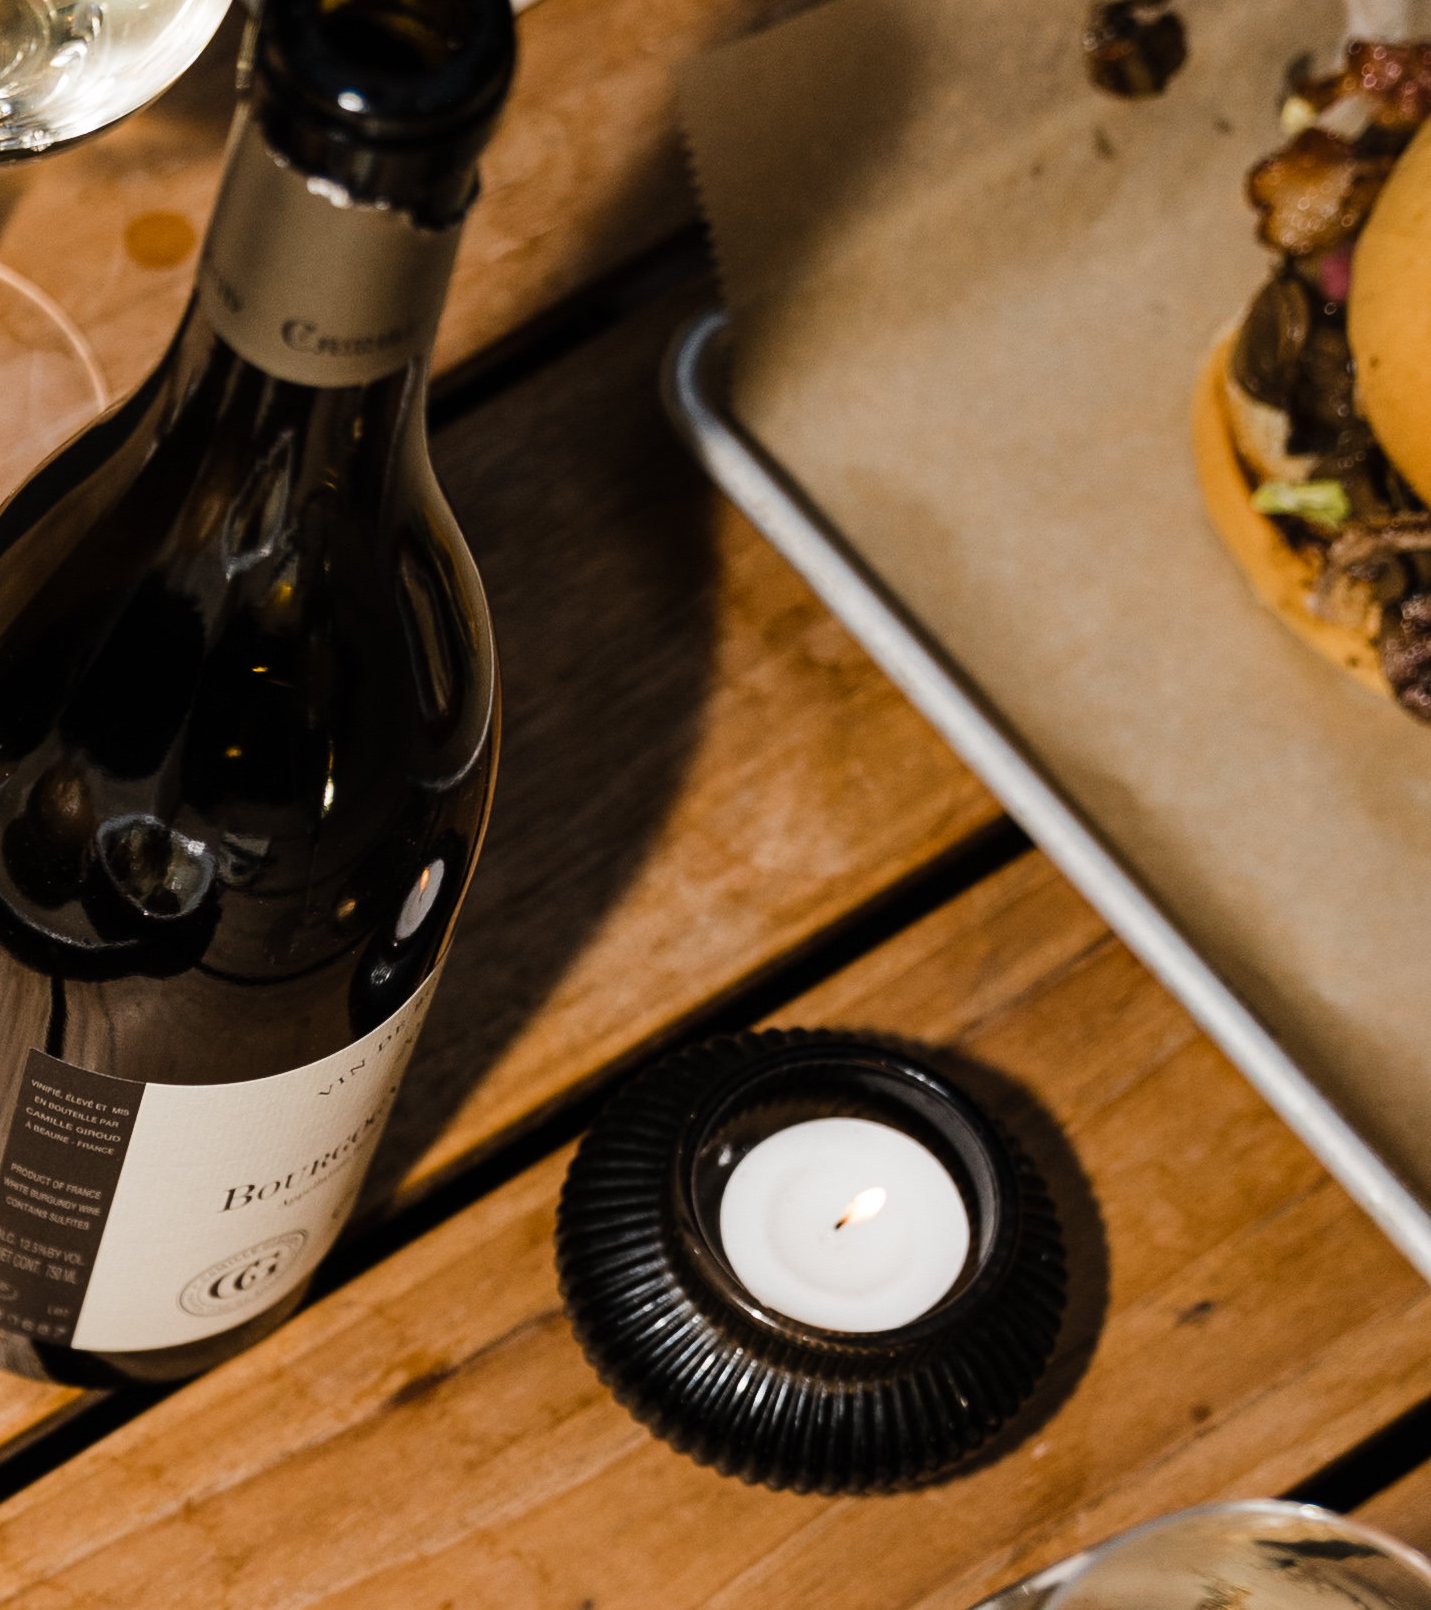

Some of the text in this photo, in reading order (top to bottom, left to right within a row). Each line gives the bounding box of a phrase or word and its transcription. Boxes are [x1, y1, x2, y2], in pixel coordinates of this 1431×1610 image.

[317, 1059, 366, 1096] VIN
[26, 1107, 121, 1142] CAMILLE GIROUD
[34, 1095, 119, 1128] EN BOUTEILLE PAR
[95, 1103, 107, 1112] ET
[111, 1107, 130, 1116] MIS
[33, 1124, 69, 1144] BEAUNE
[76, 1140, 115, 1155] FRANCE
[3, 1177, 29, 1196] WHITE
[29, 1189, 77, 1210] BURGUNDY
[10, 1162, 102, 1200] PRODUCT OF FRANCE
[5, 1195, 90, 1230] CONTAINS SULFITES
